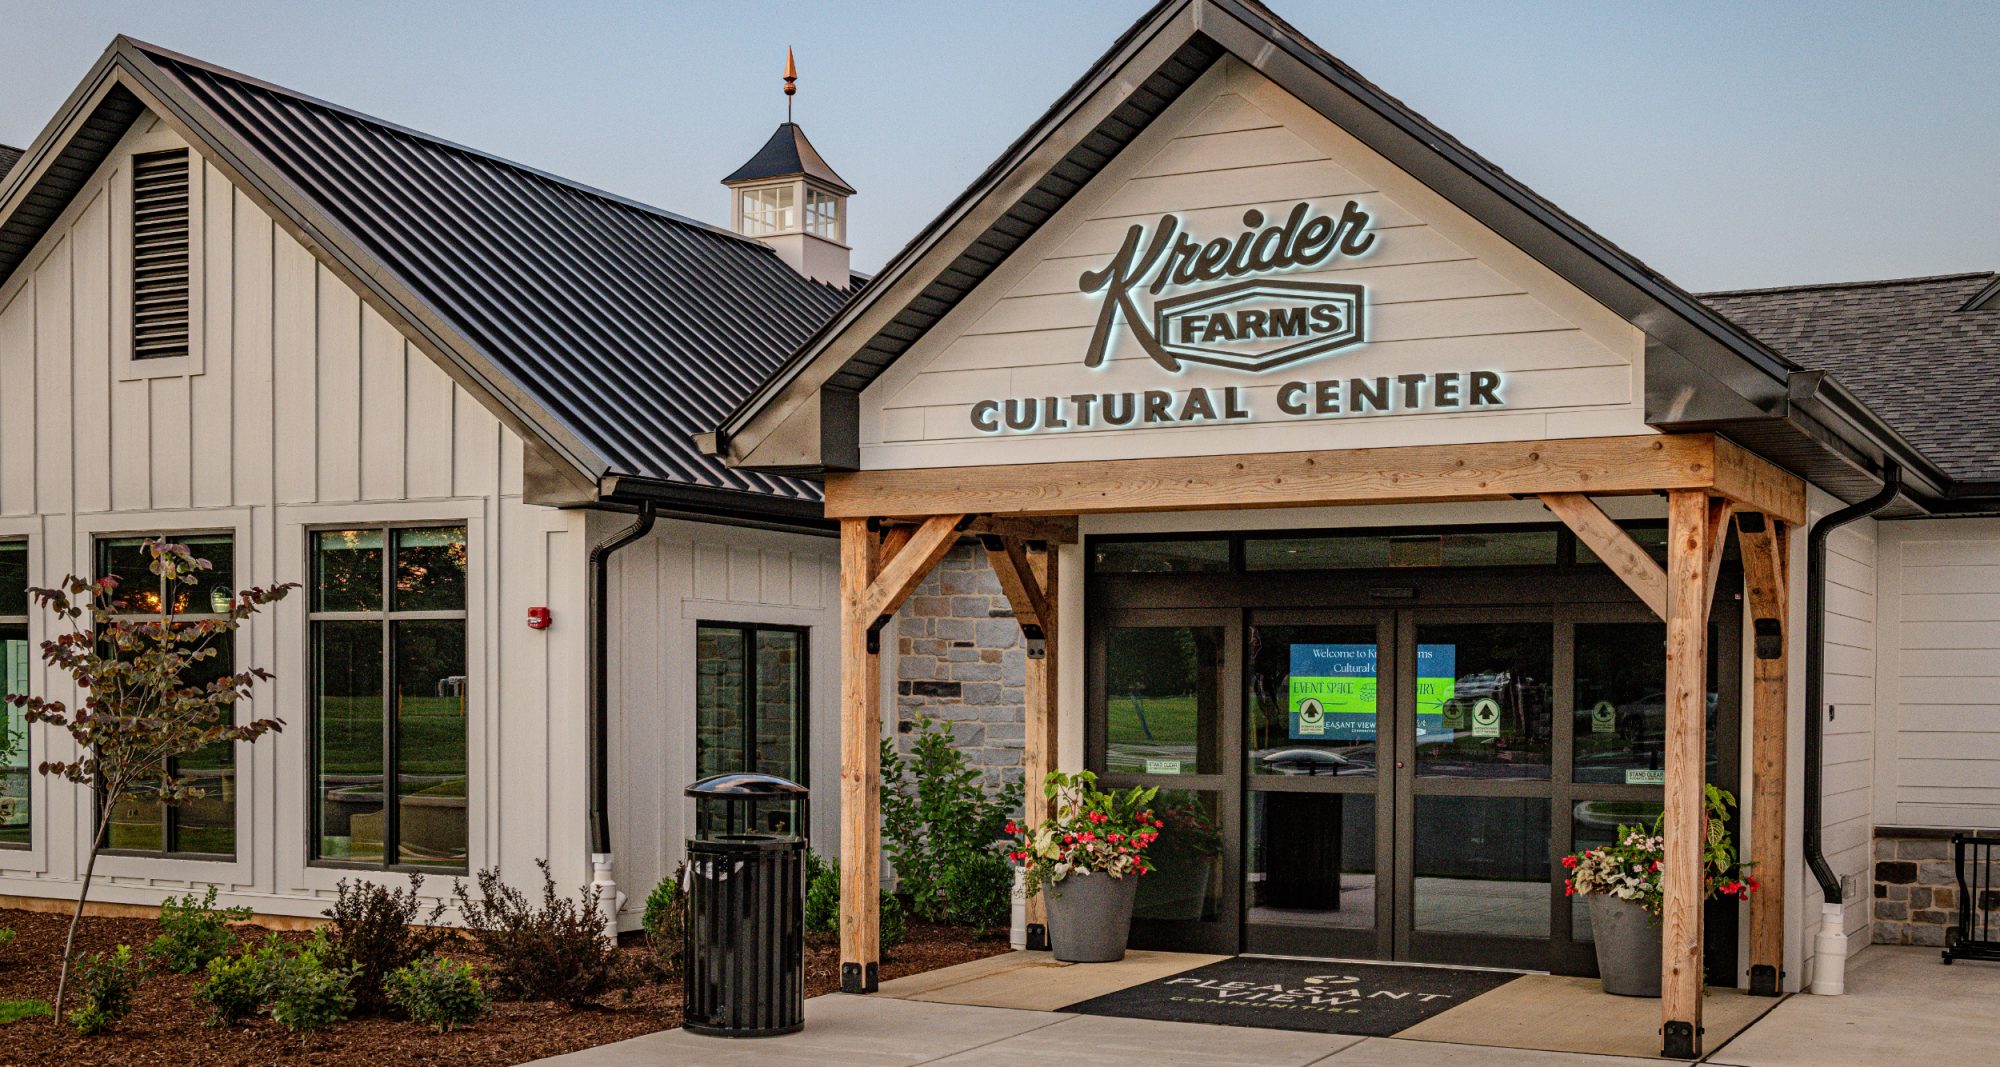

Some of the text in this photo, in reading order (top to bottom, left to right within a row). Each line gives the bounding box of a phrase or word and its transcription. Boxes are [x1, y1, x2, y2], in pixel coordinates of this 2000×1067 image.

[1079, 200, 1376, 373] Kreider
[1180, 303, 1343, 344] FARMS
[970, 370, 1504, 433] CULTURAL CENTER
[1313, 648, 1355, 658] Welcome
[1356, 649, 1367, 658] to
[1333, 662, 1370, 673] Cultural
[1293, 681, 1324, 694] EVENT
[1324, 721, 1356, 730] EASANT
[1357, 721, 1376, 729] VIEW
[1164, 977, 1452, 1003] PLEASANT
[1218, 989, 1362, 1006] VIEW
[1169, 996, 1361, 1014] COMMUNITIES
